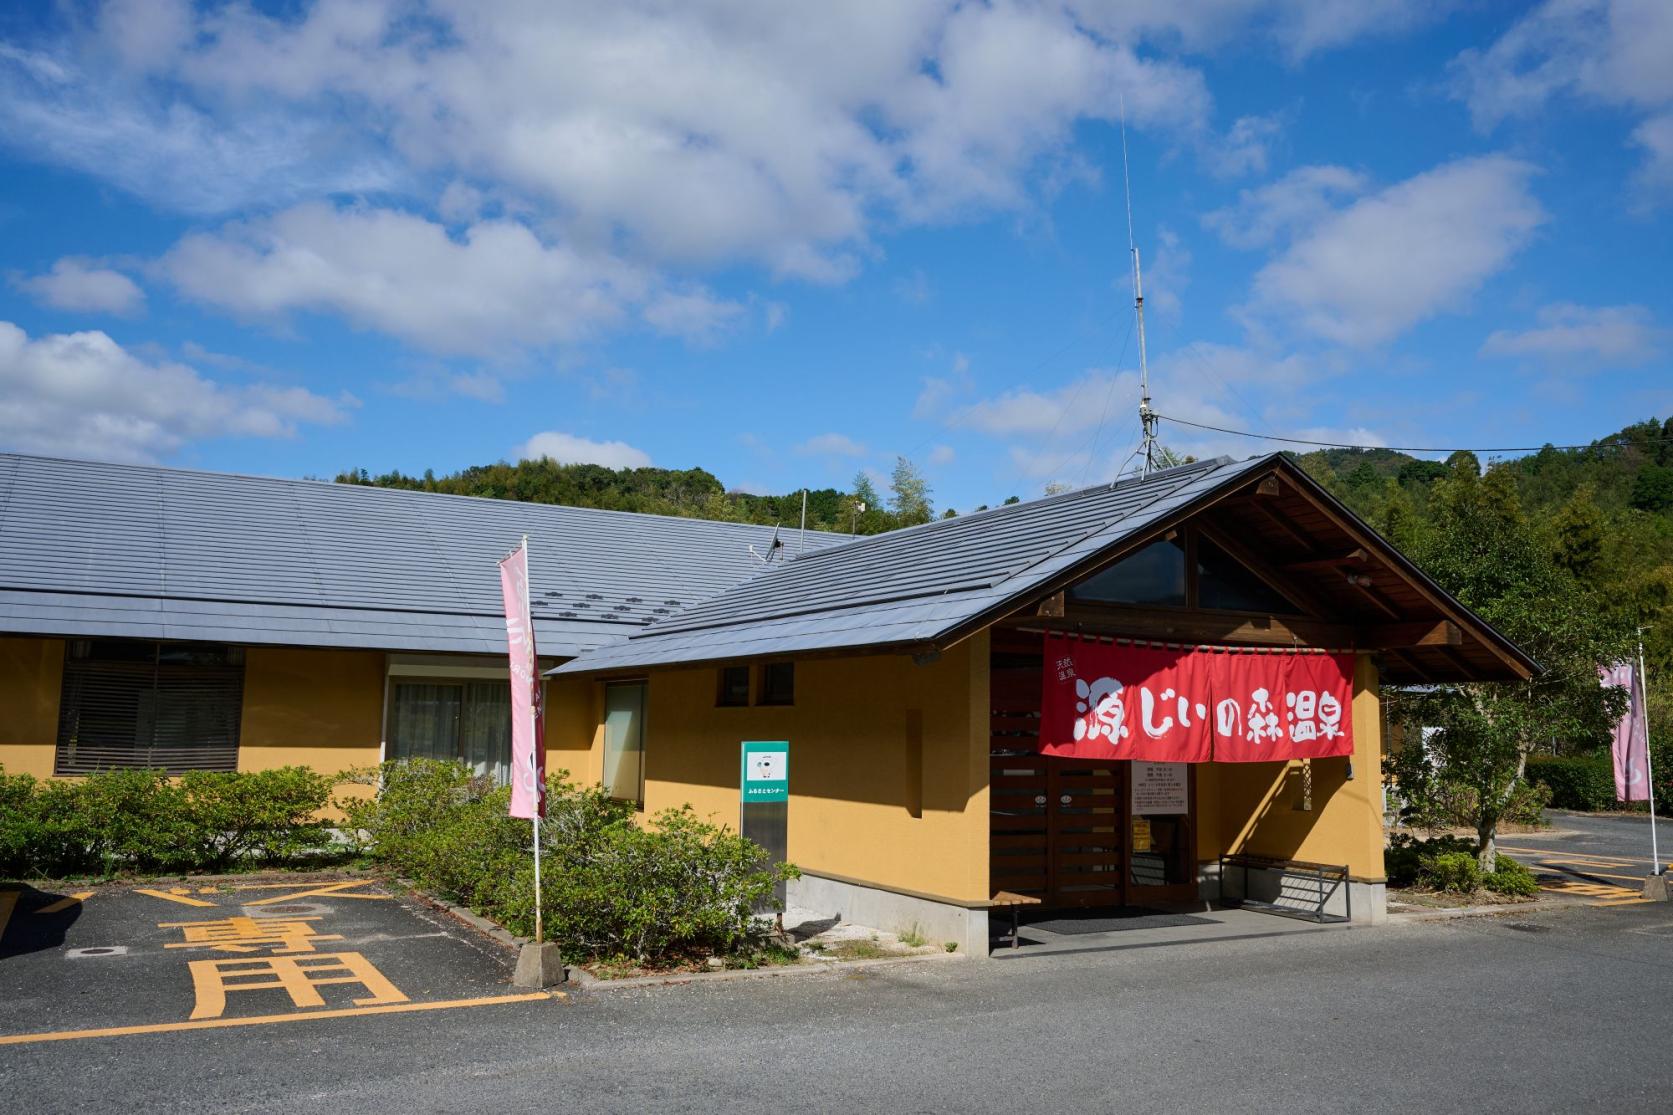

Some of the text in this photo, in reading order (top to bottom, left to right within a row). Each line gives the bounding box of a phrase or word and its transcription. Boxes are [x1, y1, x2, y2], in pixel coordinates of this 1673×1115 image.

[1073, 676, 1345, 745] 源じいの森温泉
